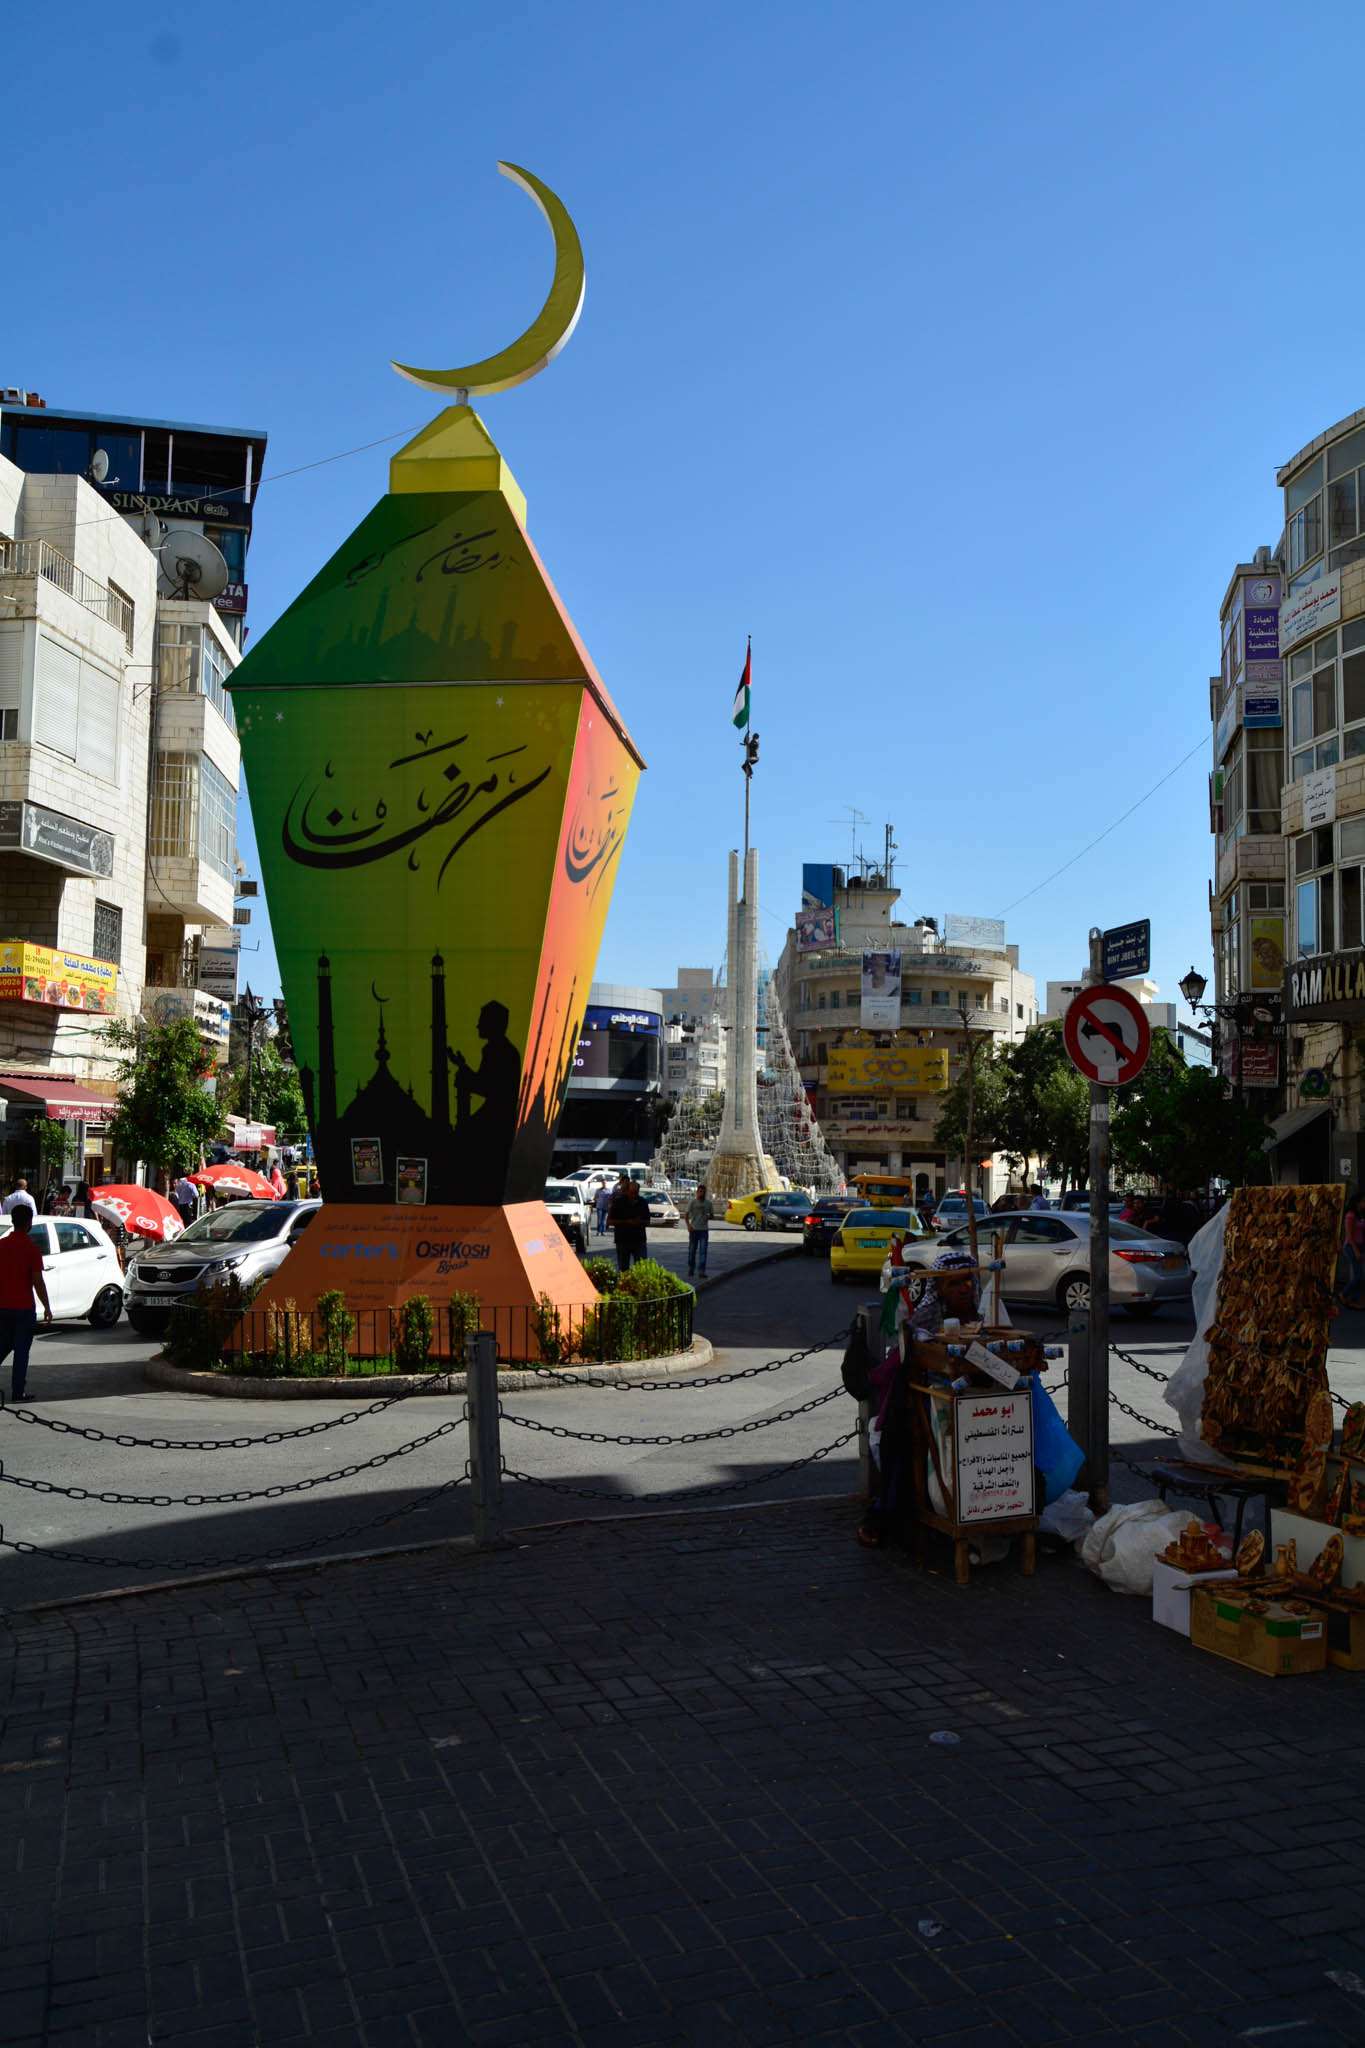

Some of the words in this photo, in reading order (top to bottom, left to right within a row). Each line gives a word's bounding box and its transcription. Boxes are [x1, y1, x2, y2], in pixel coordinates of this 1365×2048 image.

[112, 492, 200, 515] SINDYAN
[1252, 615, 1275, 626] العيادة
[319, 1240, 403, 1260] carter's
[971, 1405, 998, 1418] محمد
[1000, 1401, 1015, 1418] ابو
